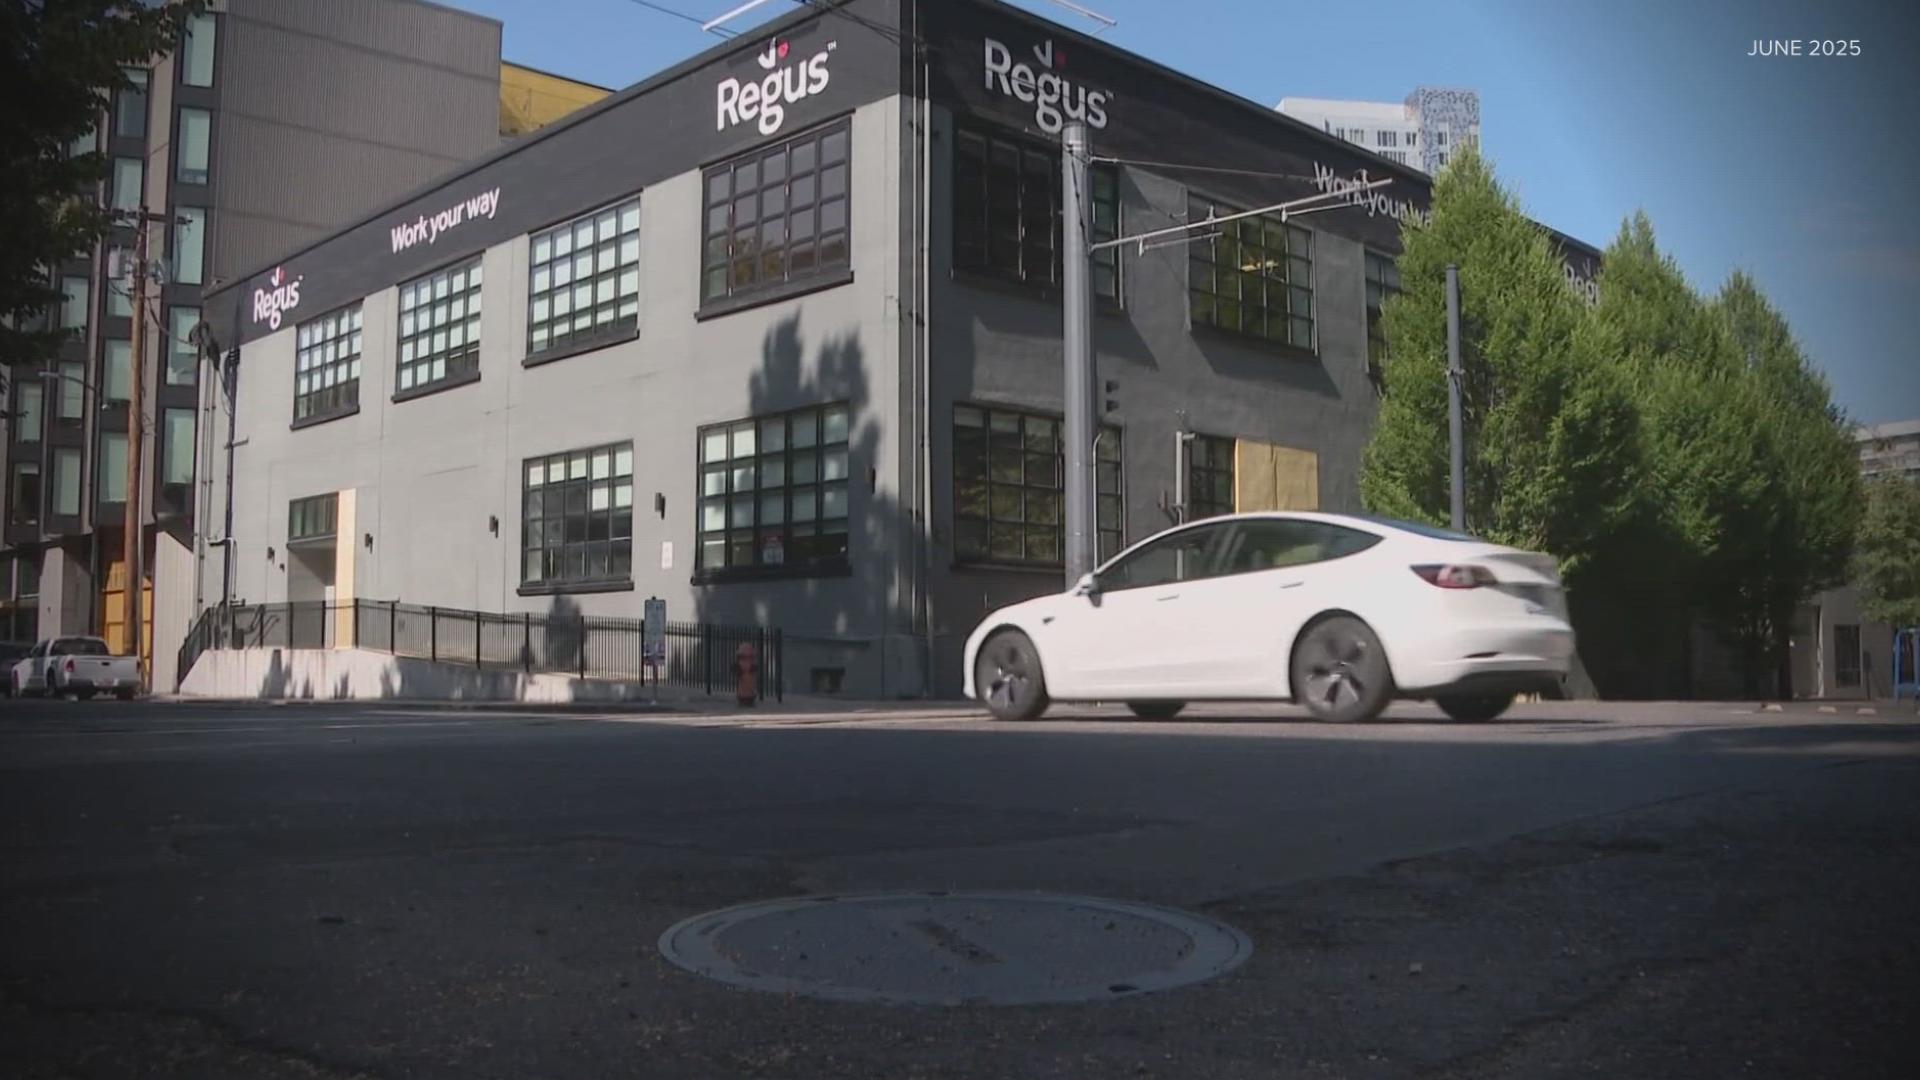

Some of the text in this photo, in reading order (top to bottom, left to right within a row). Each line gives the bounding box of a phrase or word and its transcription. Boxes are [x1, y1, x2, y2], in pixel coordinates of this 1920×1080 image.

[717, 51, 830, 136] Regus
[984, 38, 1108, 135] Regus
[391, 187, 500, 254] Work your way
[254, 281, 300, 330] Regus
